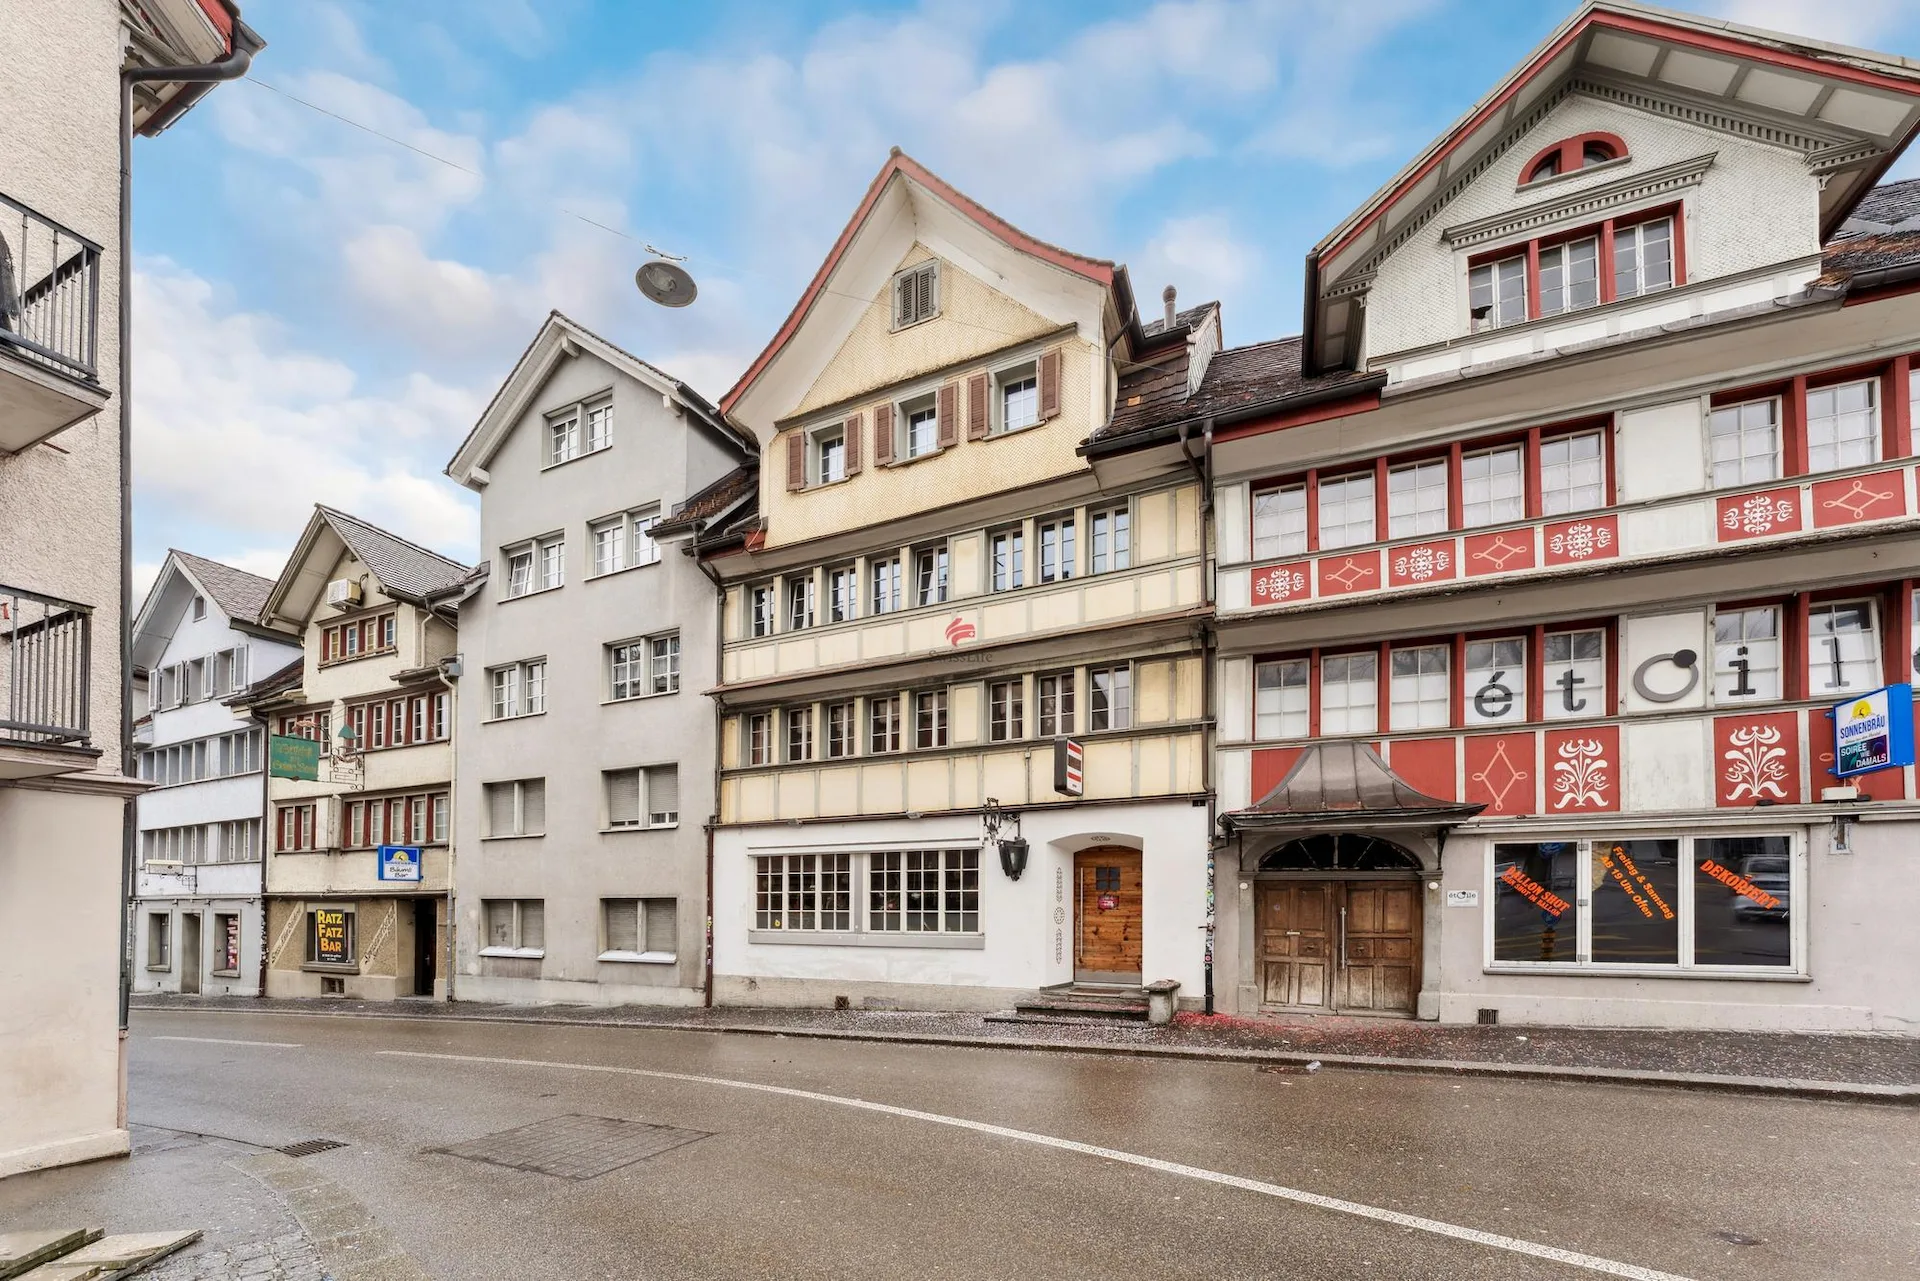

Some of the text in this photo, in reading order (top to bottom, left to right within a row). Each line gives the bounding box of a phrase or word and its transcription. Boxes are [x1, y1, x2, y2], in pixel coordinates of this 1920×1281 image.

[1840, 713, 1886, 740] SONNENBRÄU
[1856, 753, 1887, 768] DAMALS
[1611, 869, 1623, 879] 19
[1620, 879, 1635, 895] Uhr
[1613, 846, 1638, 876] Freitag
[1643, 883, 1674, 919] Samstag
[1541, 892, 1571, 912] SHOT
[317, 910, 343, 924] RATZ
[318, 924, 344, 938] FATZ
[320, 938, 342, 952] BAR
